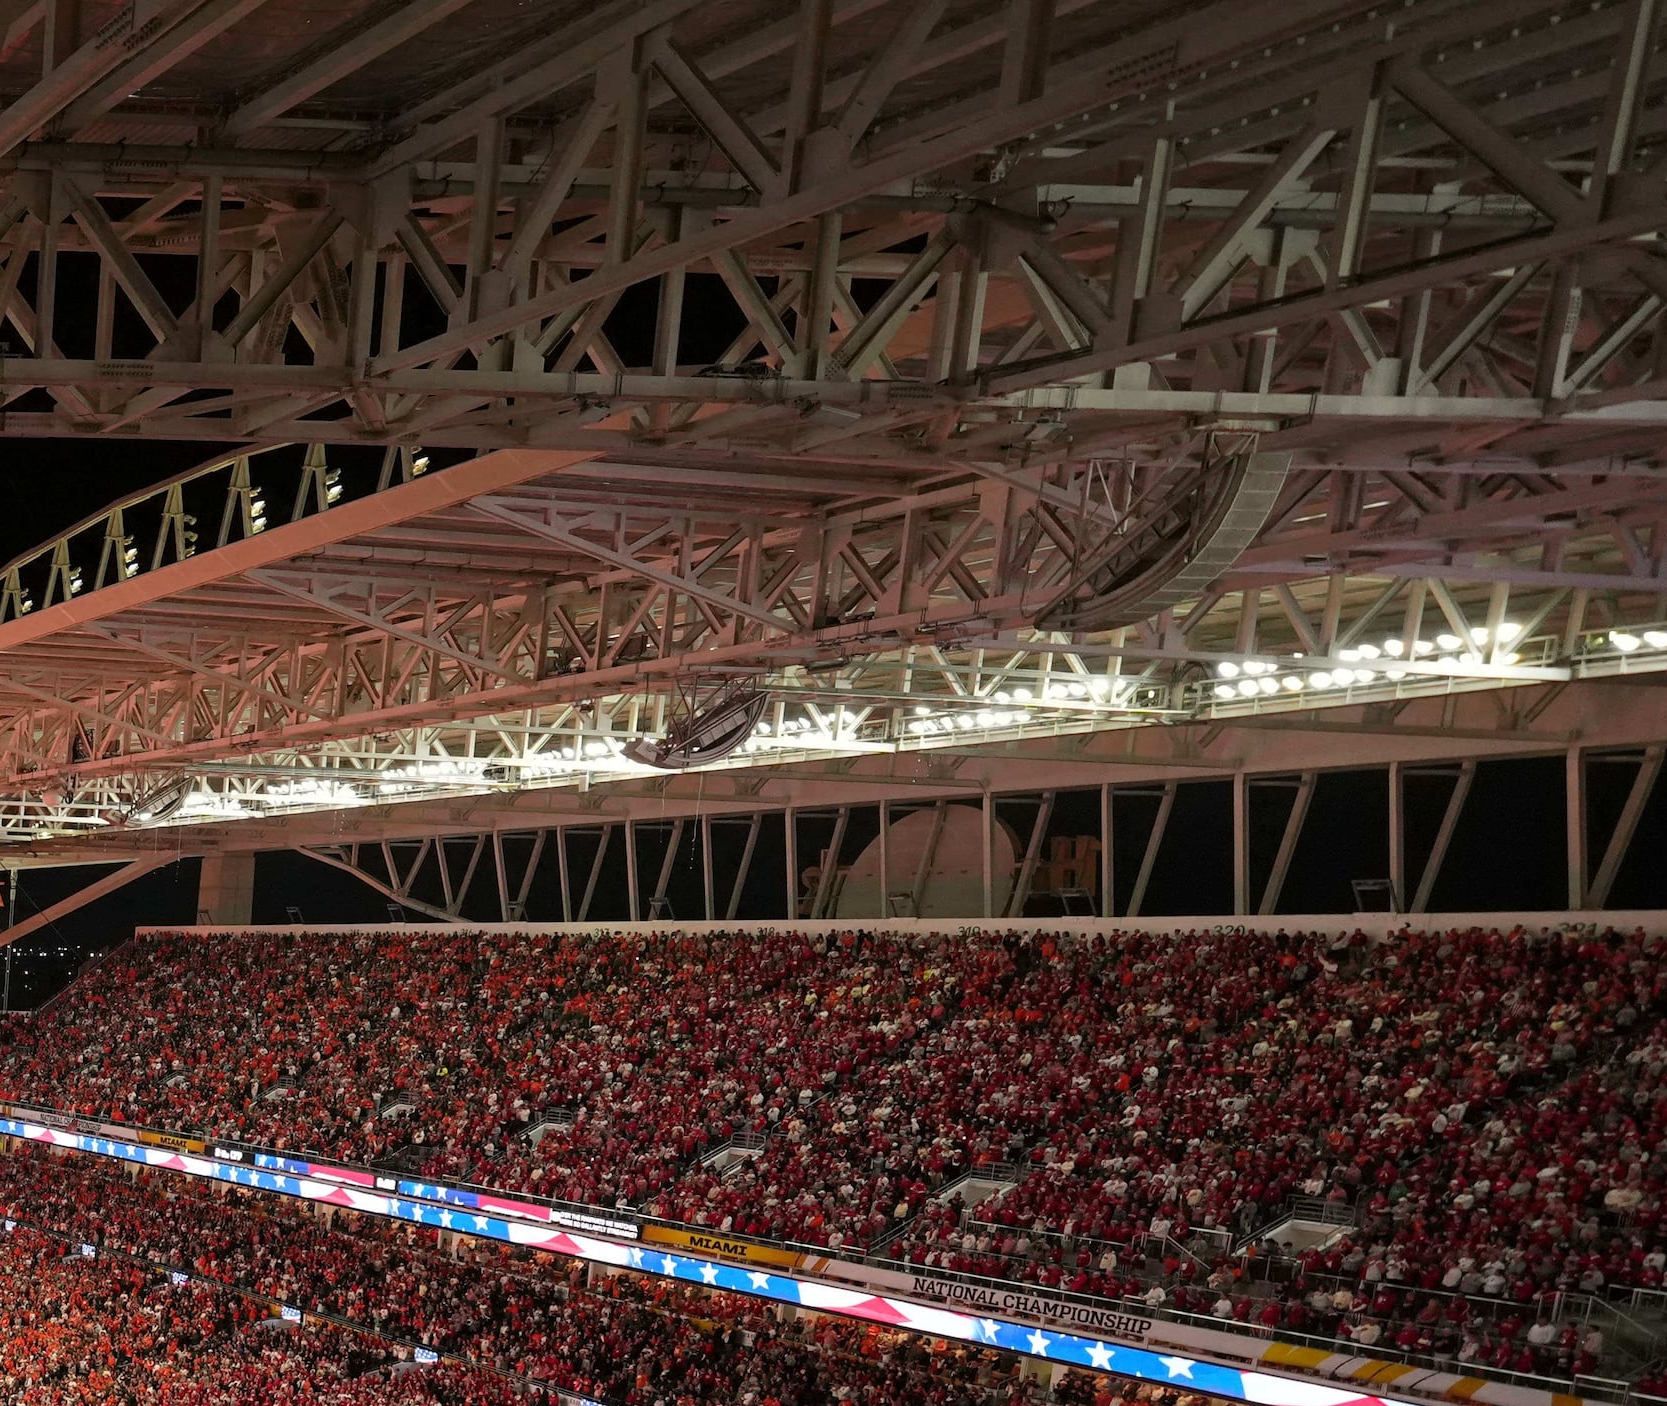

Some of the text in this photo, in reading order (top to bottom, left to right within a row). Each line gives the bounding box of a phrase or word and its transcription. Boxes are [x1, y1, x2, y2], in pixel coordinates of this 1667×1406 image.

[160, 1136, 188, 1148] MIAMI
[689, 1235, 748, 1256] MIAMI
[913, 1277, 1152, 1334] NATIONAL CHAMPIONSHIP
